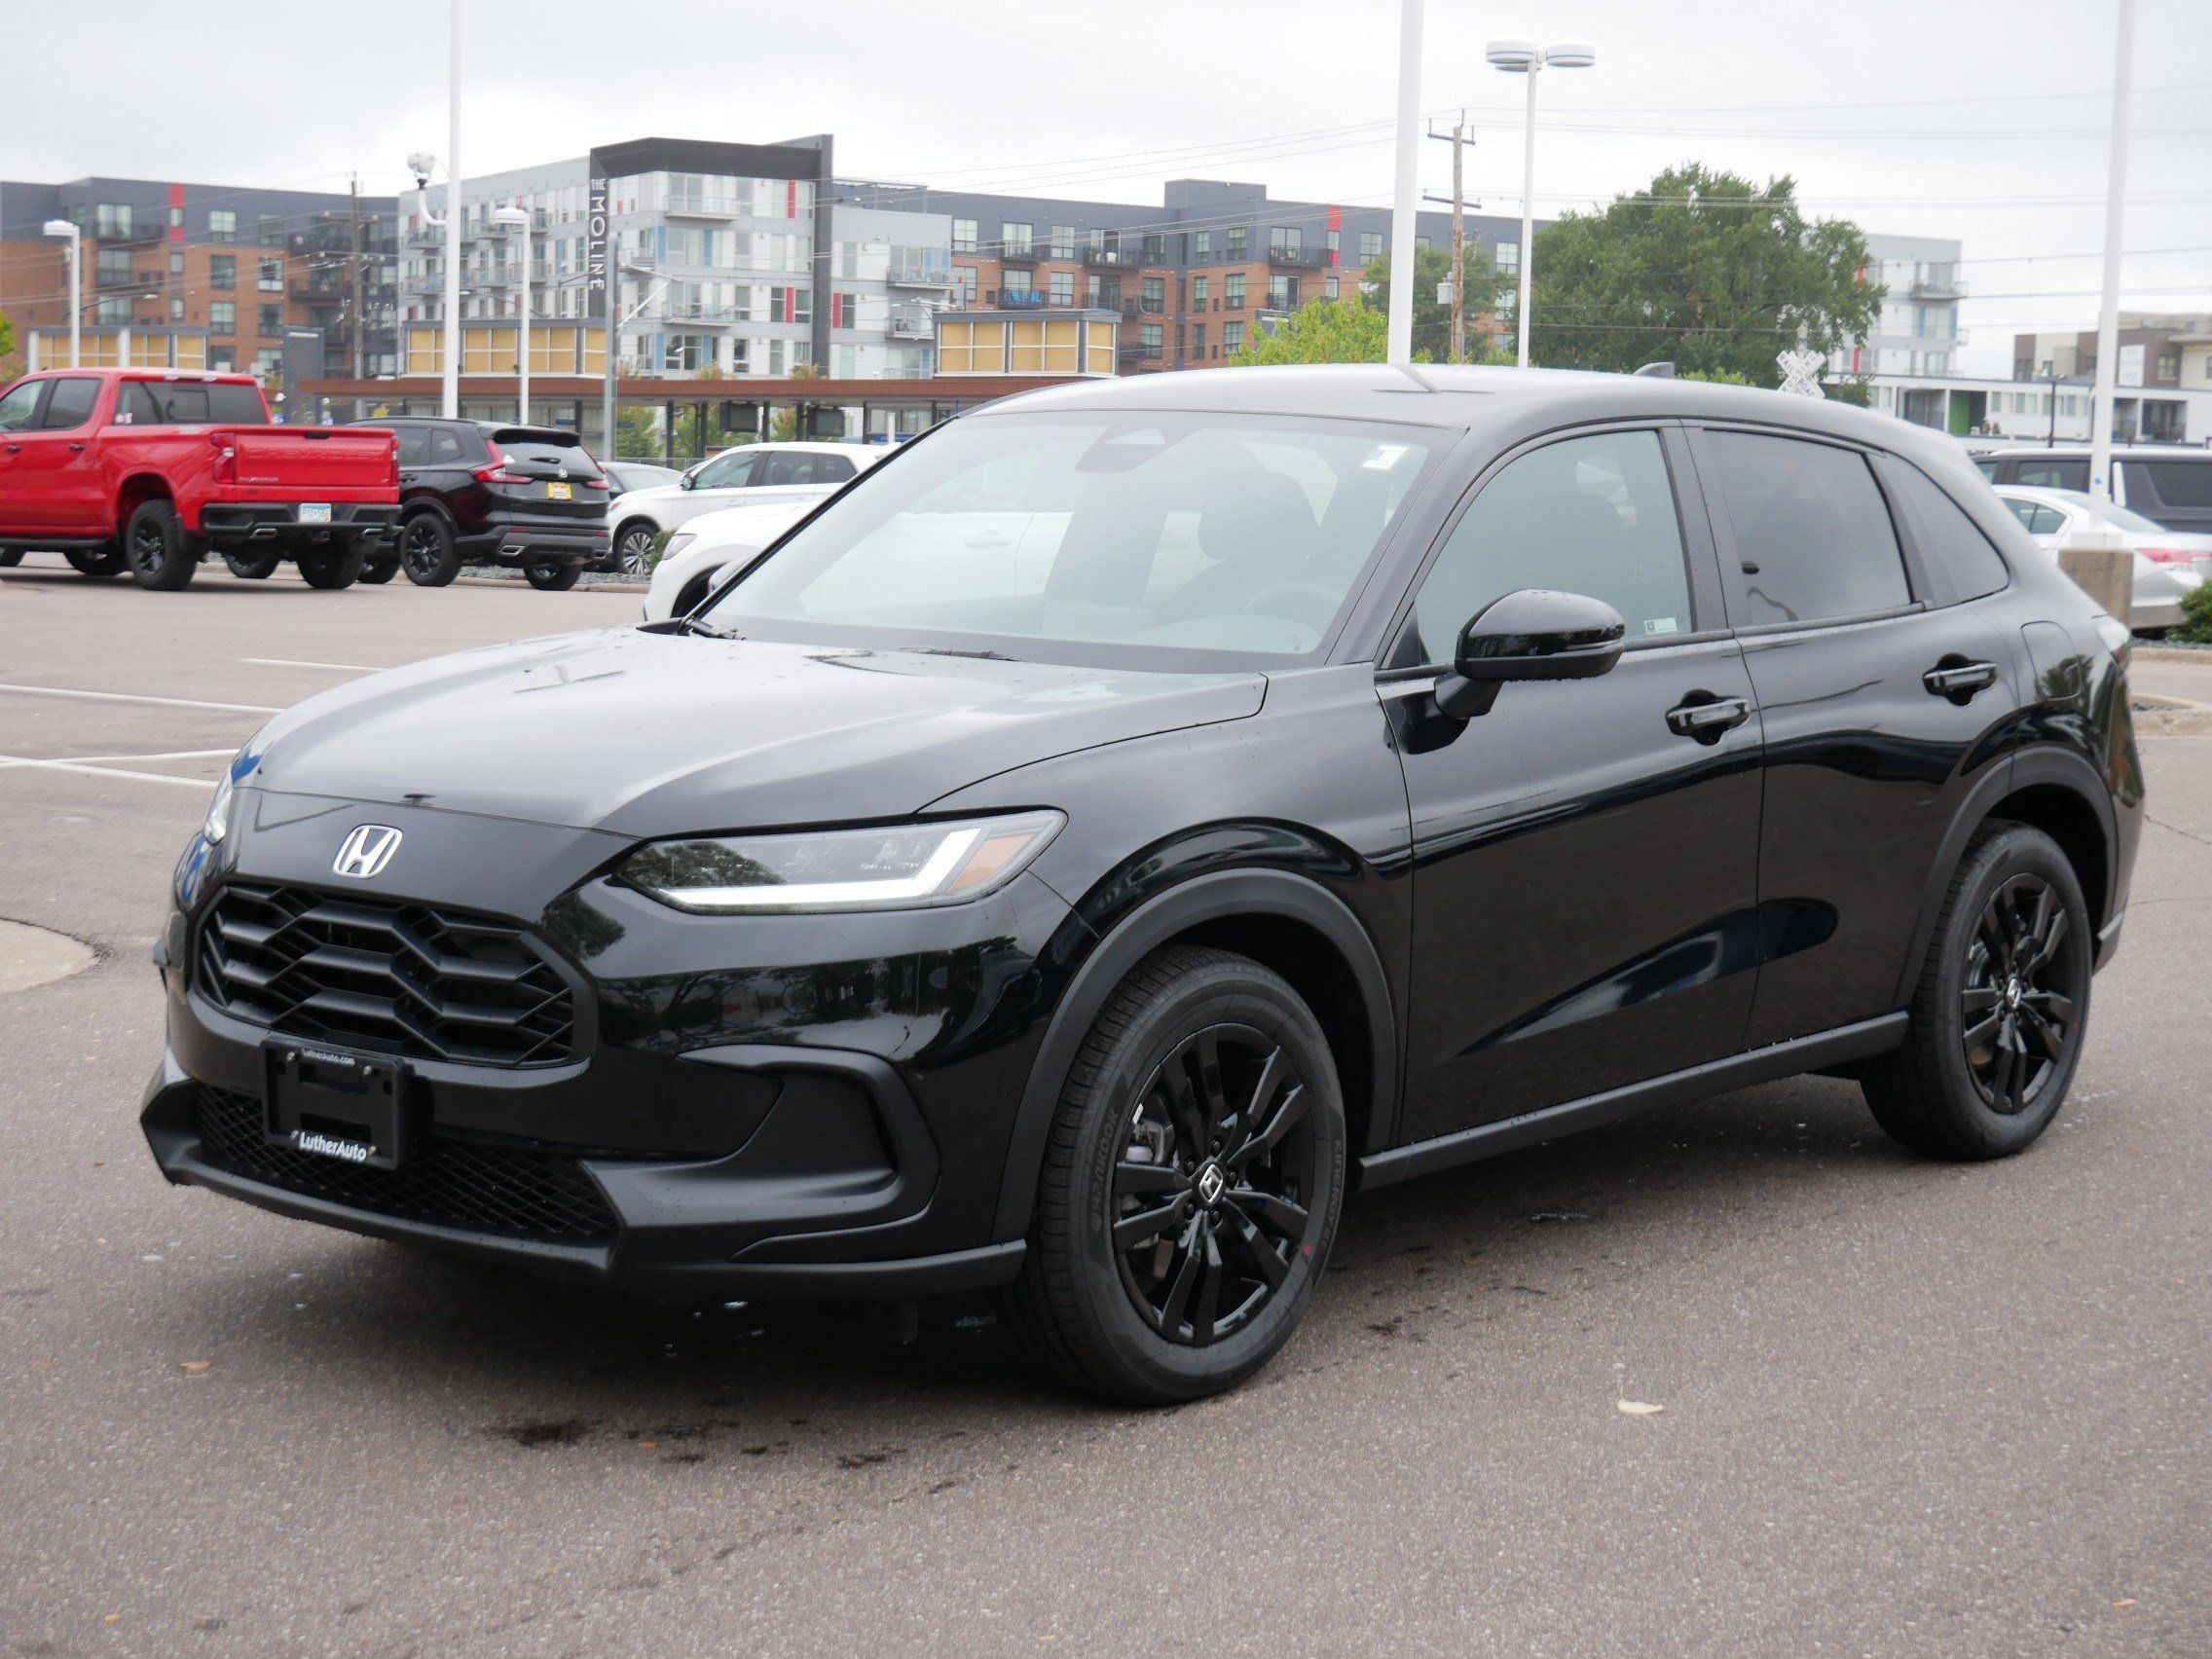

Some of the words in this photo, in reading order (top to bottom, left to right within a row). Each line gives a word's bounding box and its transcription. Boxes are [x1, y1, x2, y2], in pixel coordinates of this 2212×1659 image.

[590, 178, 606, 191] THE
[590, 196, 606, 290] MOLINE
[1781, 354, 1816, 392] ROSSING
[300, 1132, 367, 1161] LutherAuto
